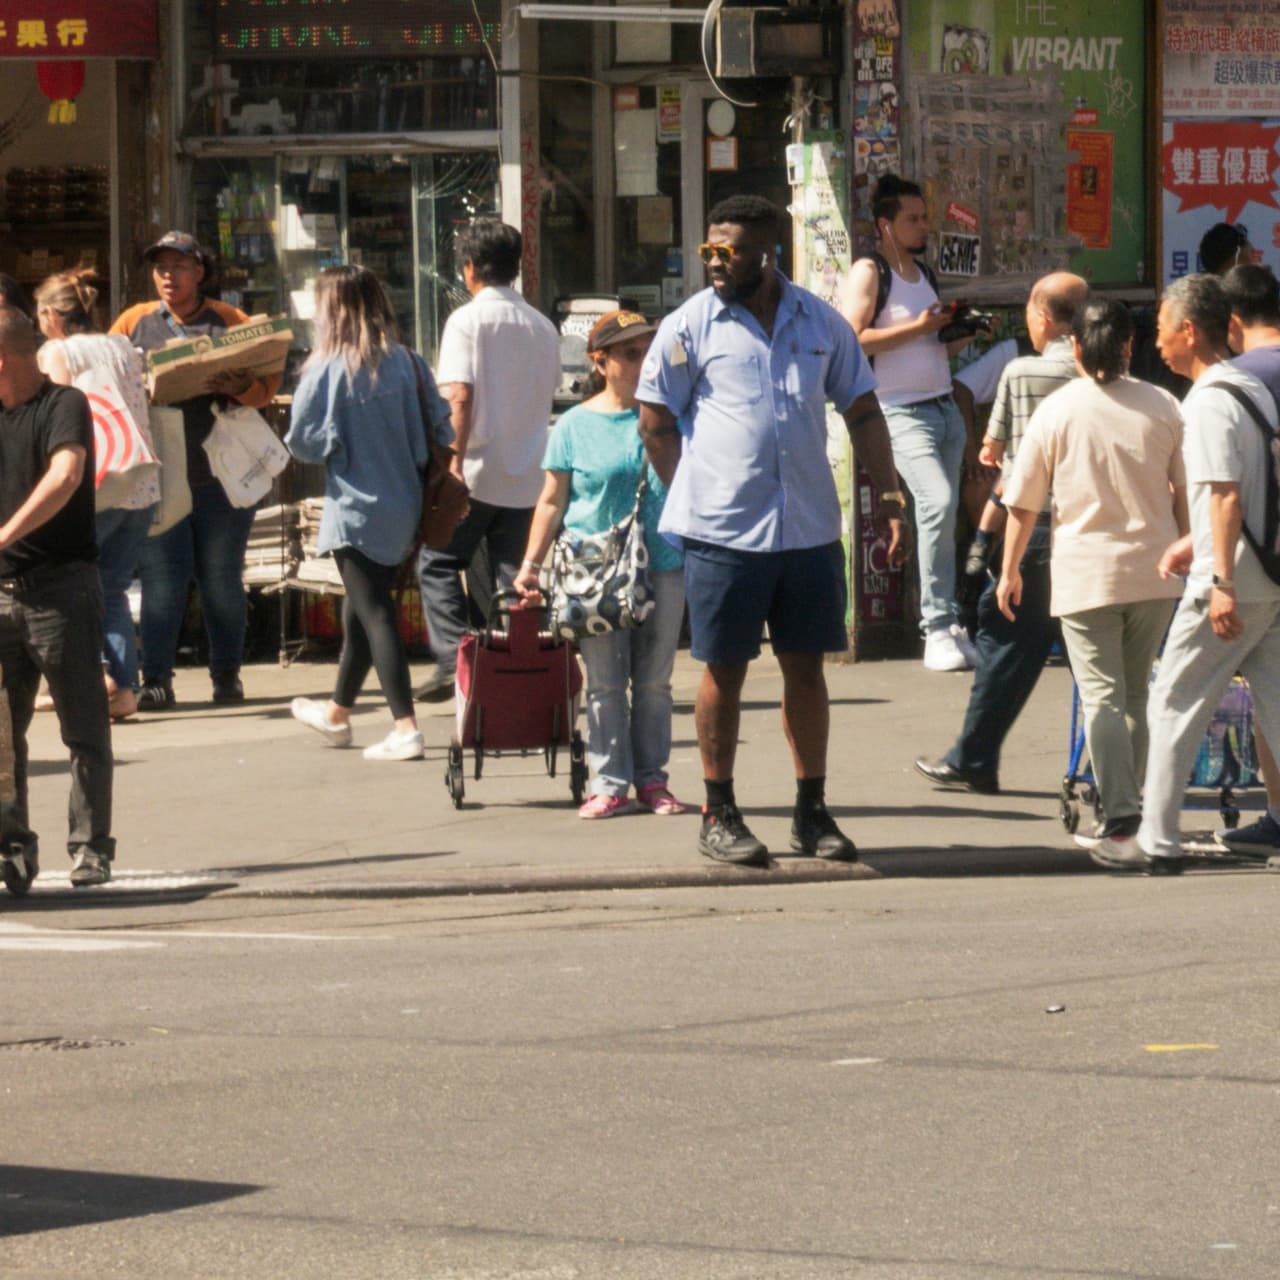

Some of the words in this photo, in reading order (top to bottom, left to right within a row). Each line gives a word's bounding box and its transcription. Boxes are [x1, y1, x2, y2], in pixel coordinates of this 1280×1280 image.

[1011, 36, 1123, 71] VIBRANT
[1171, 147, 1269, 186] 雙重優惠
[219, 324, 274, 346] TOMATES
